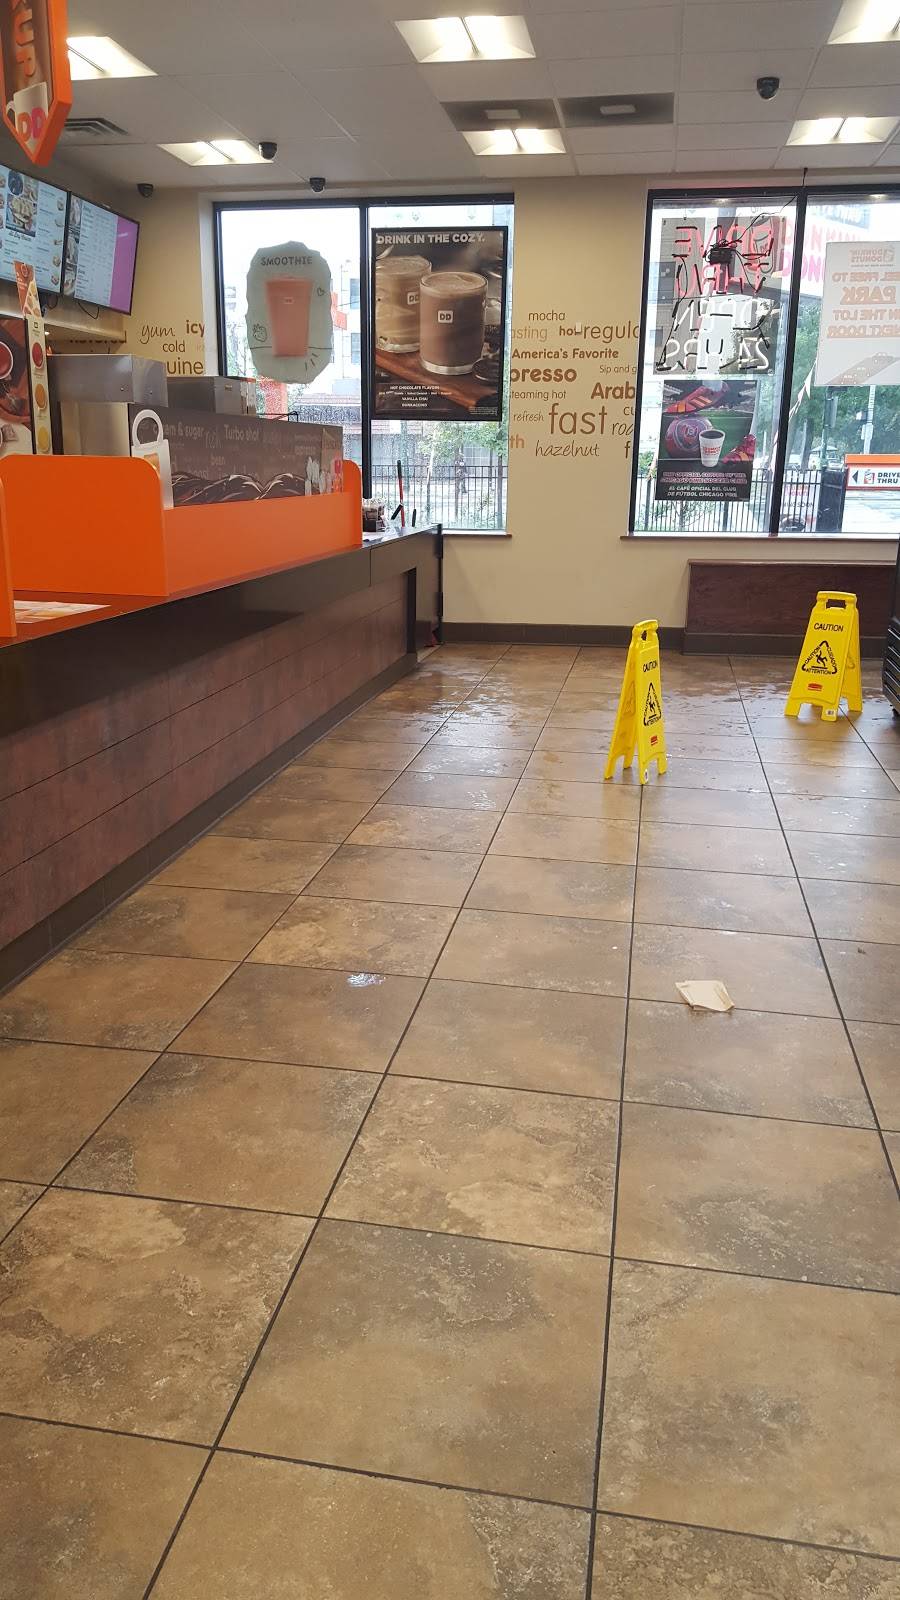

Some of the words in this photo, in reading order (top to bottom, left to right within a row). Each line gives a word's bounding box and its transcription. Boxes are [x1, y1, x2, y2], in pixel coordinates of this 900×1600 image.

[376, 234, 411, 245] DRINK
[413, 234, 425, 244] IN
[428, 233, 449, 243] THE
[452, 232, 485, 243] COZY.
[260, 255, 313, 267] SMOOTHIE
[439, 313, 452, 321] DD
[528, 309, 565, 321] mocha
[186, 319, 205, 338] icy
[162, 340, 186, 353] cold
[511, 347, 568, 359] America's
[572, 347, 619, 359] Favorite
[167, 356, 204, 375] uine
[599, 364, 612, 376] Sip
[613, 364, 630, 374] and
[551, 390, 567, 399] hot
[590, 381, 636, 400] Arab
[513, 410, 545, 422] refresh
[548, 402, 608, 435] fast
[185, 425, 205, 440] sugar
[223, 424, 245, 441] Turbo
[535, 439, 600, 457] hazelnut
[814, 622, 844, 632] CAUTION
[643, 660, 658, 673] CAUTION
